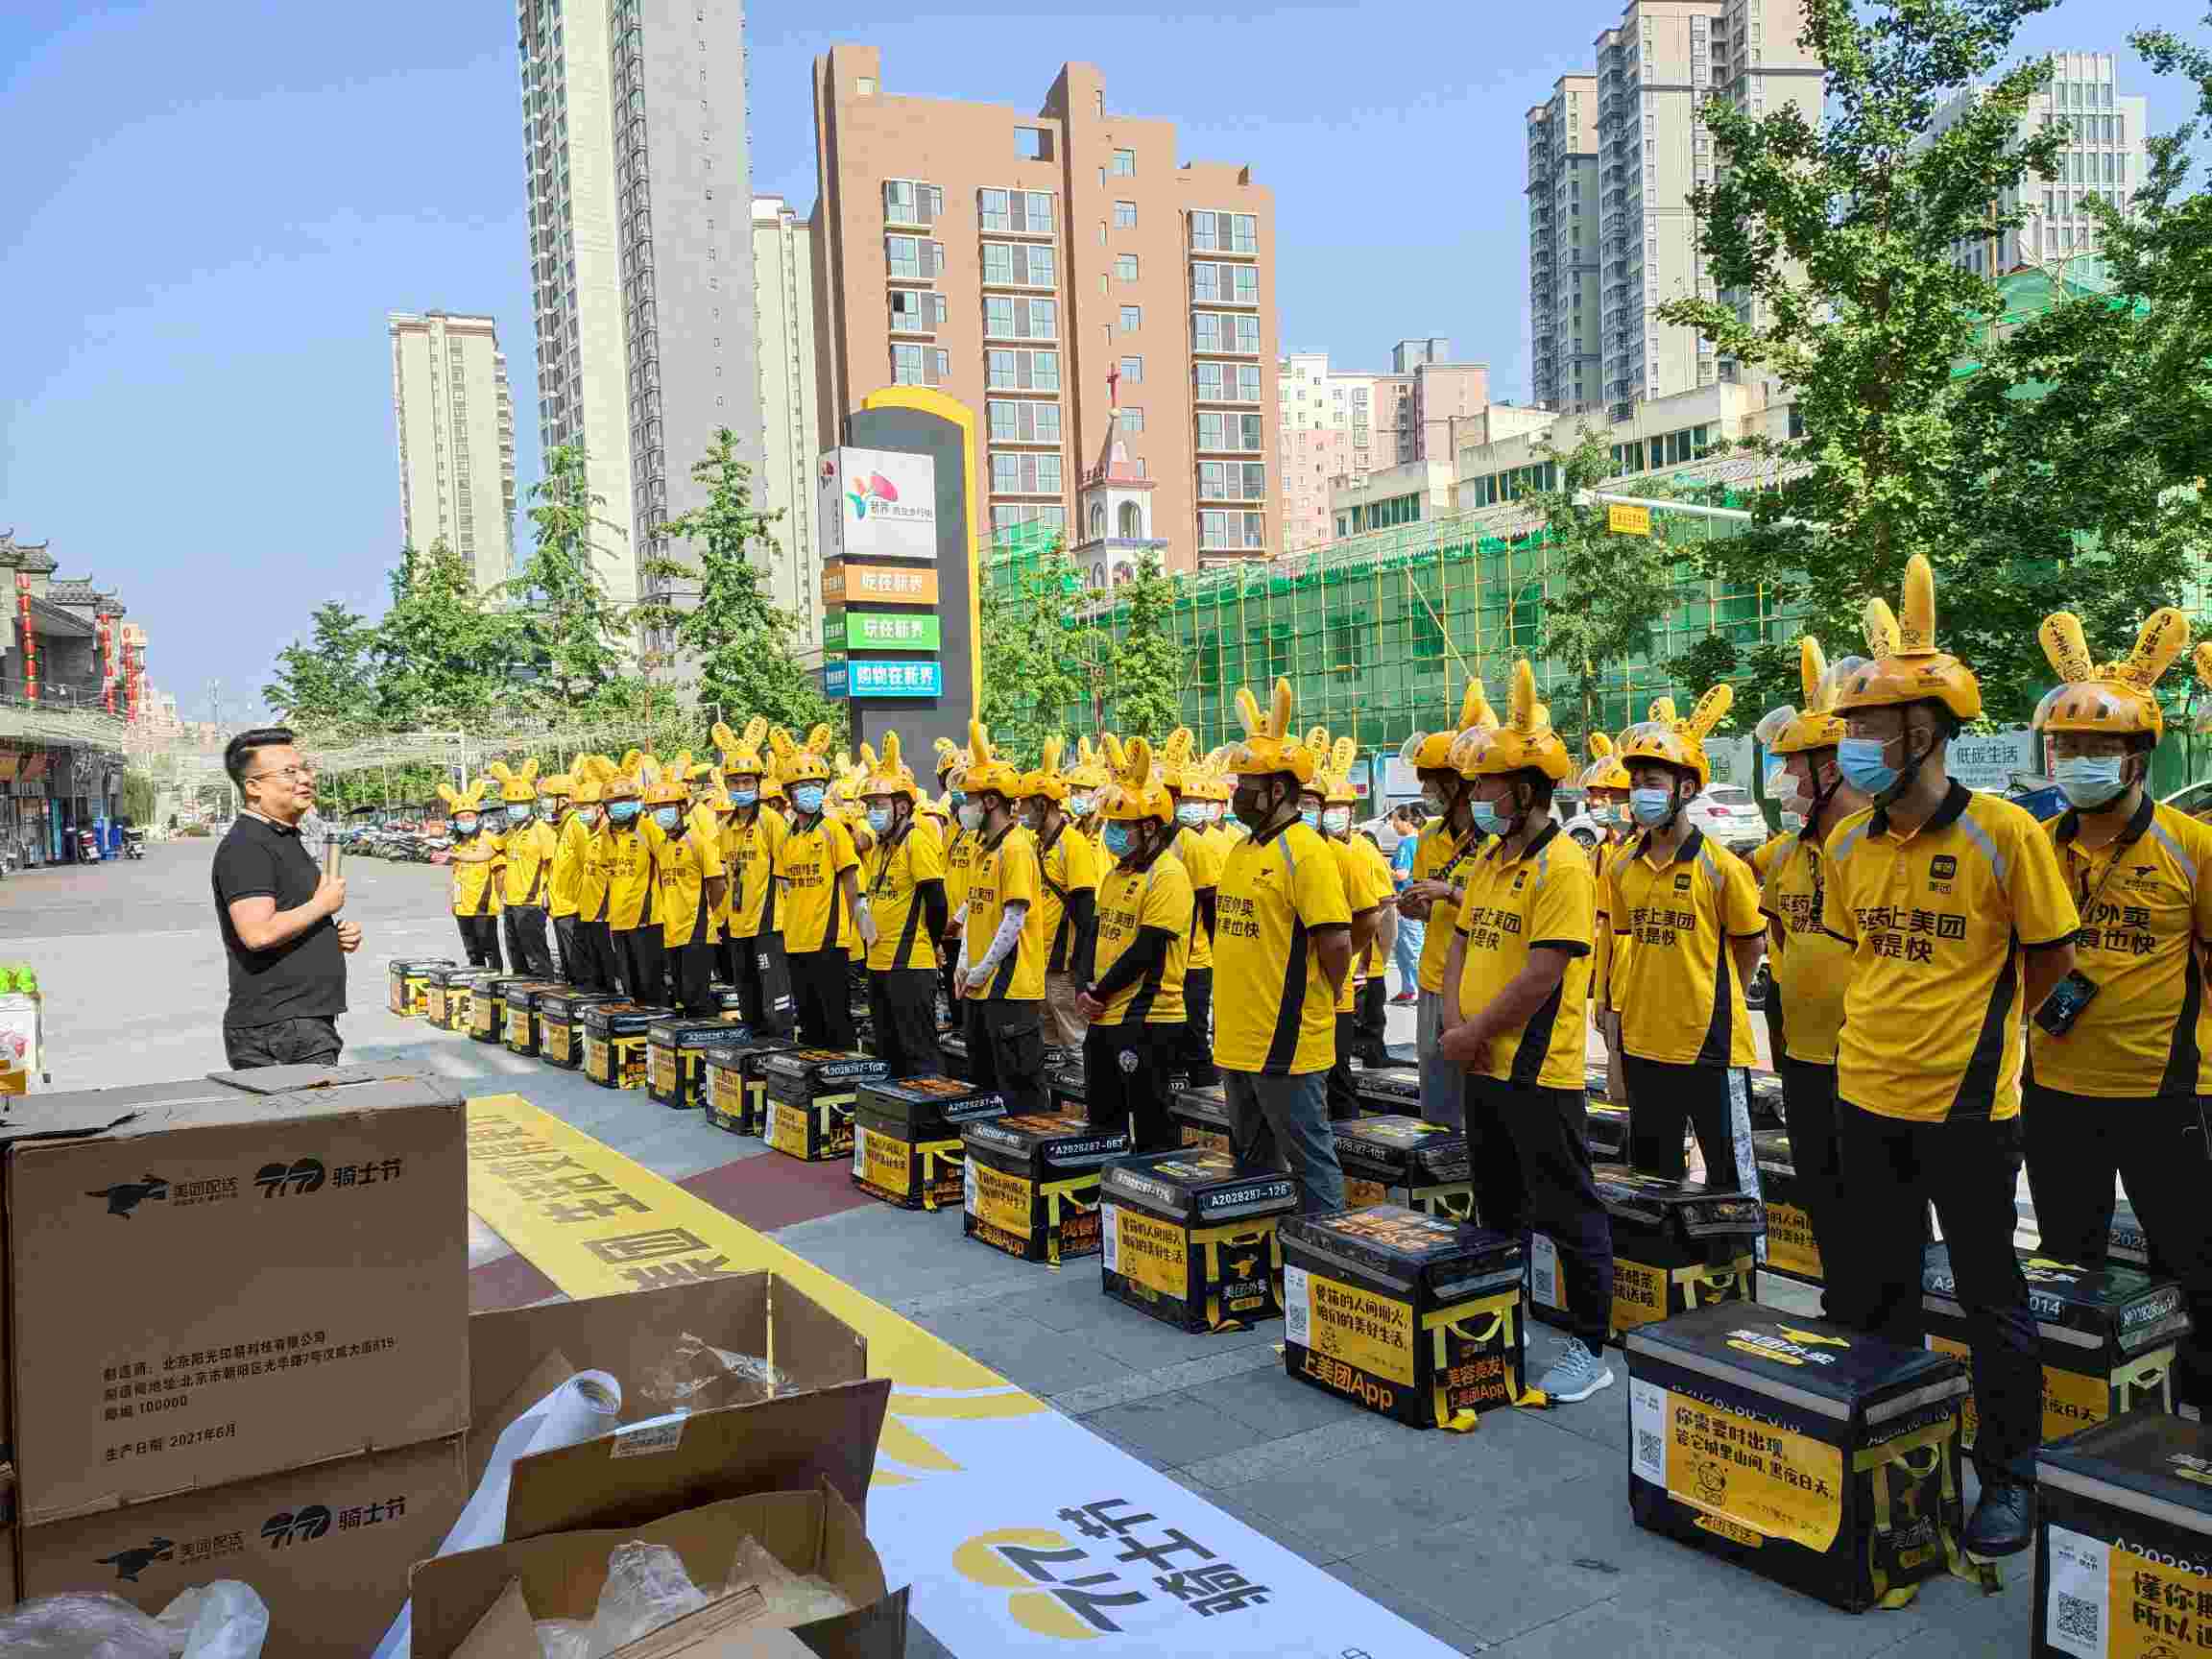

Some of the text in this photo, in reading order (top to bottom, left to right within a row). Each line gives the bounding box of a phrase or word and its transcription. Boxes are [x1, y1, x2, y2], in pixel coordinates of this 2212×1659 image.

[1957, 744, 2019, 764] 低碳生活
[331, 1158, 401, 1189] 骑士节
[1302, 1350, 1393, 1413] 上美团App
[338, 1496, 406, 1531] 骑士节
[1055, 1498, 1273, 1618] 骑士节
